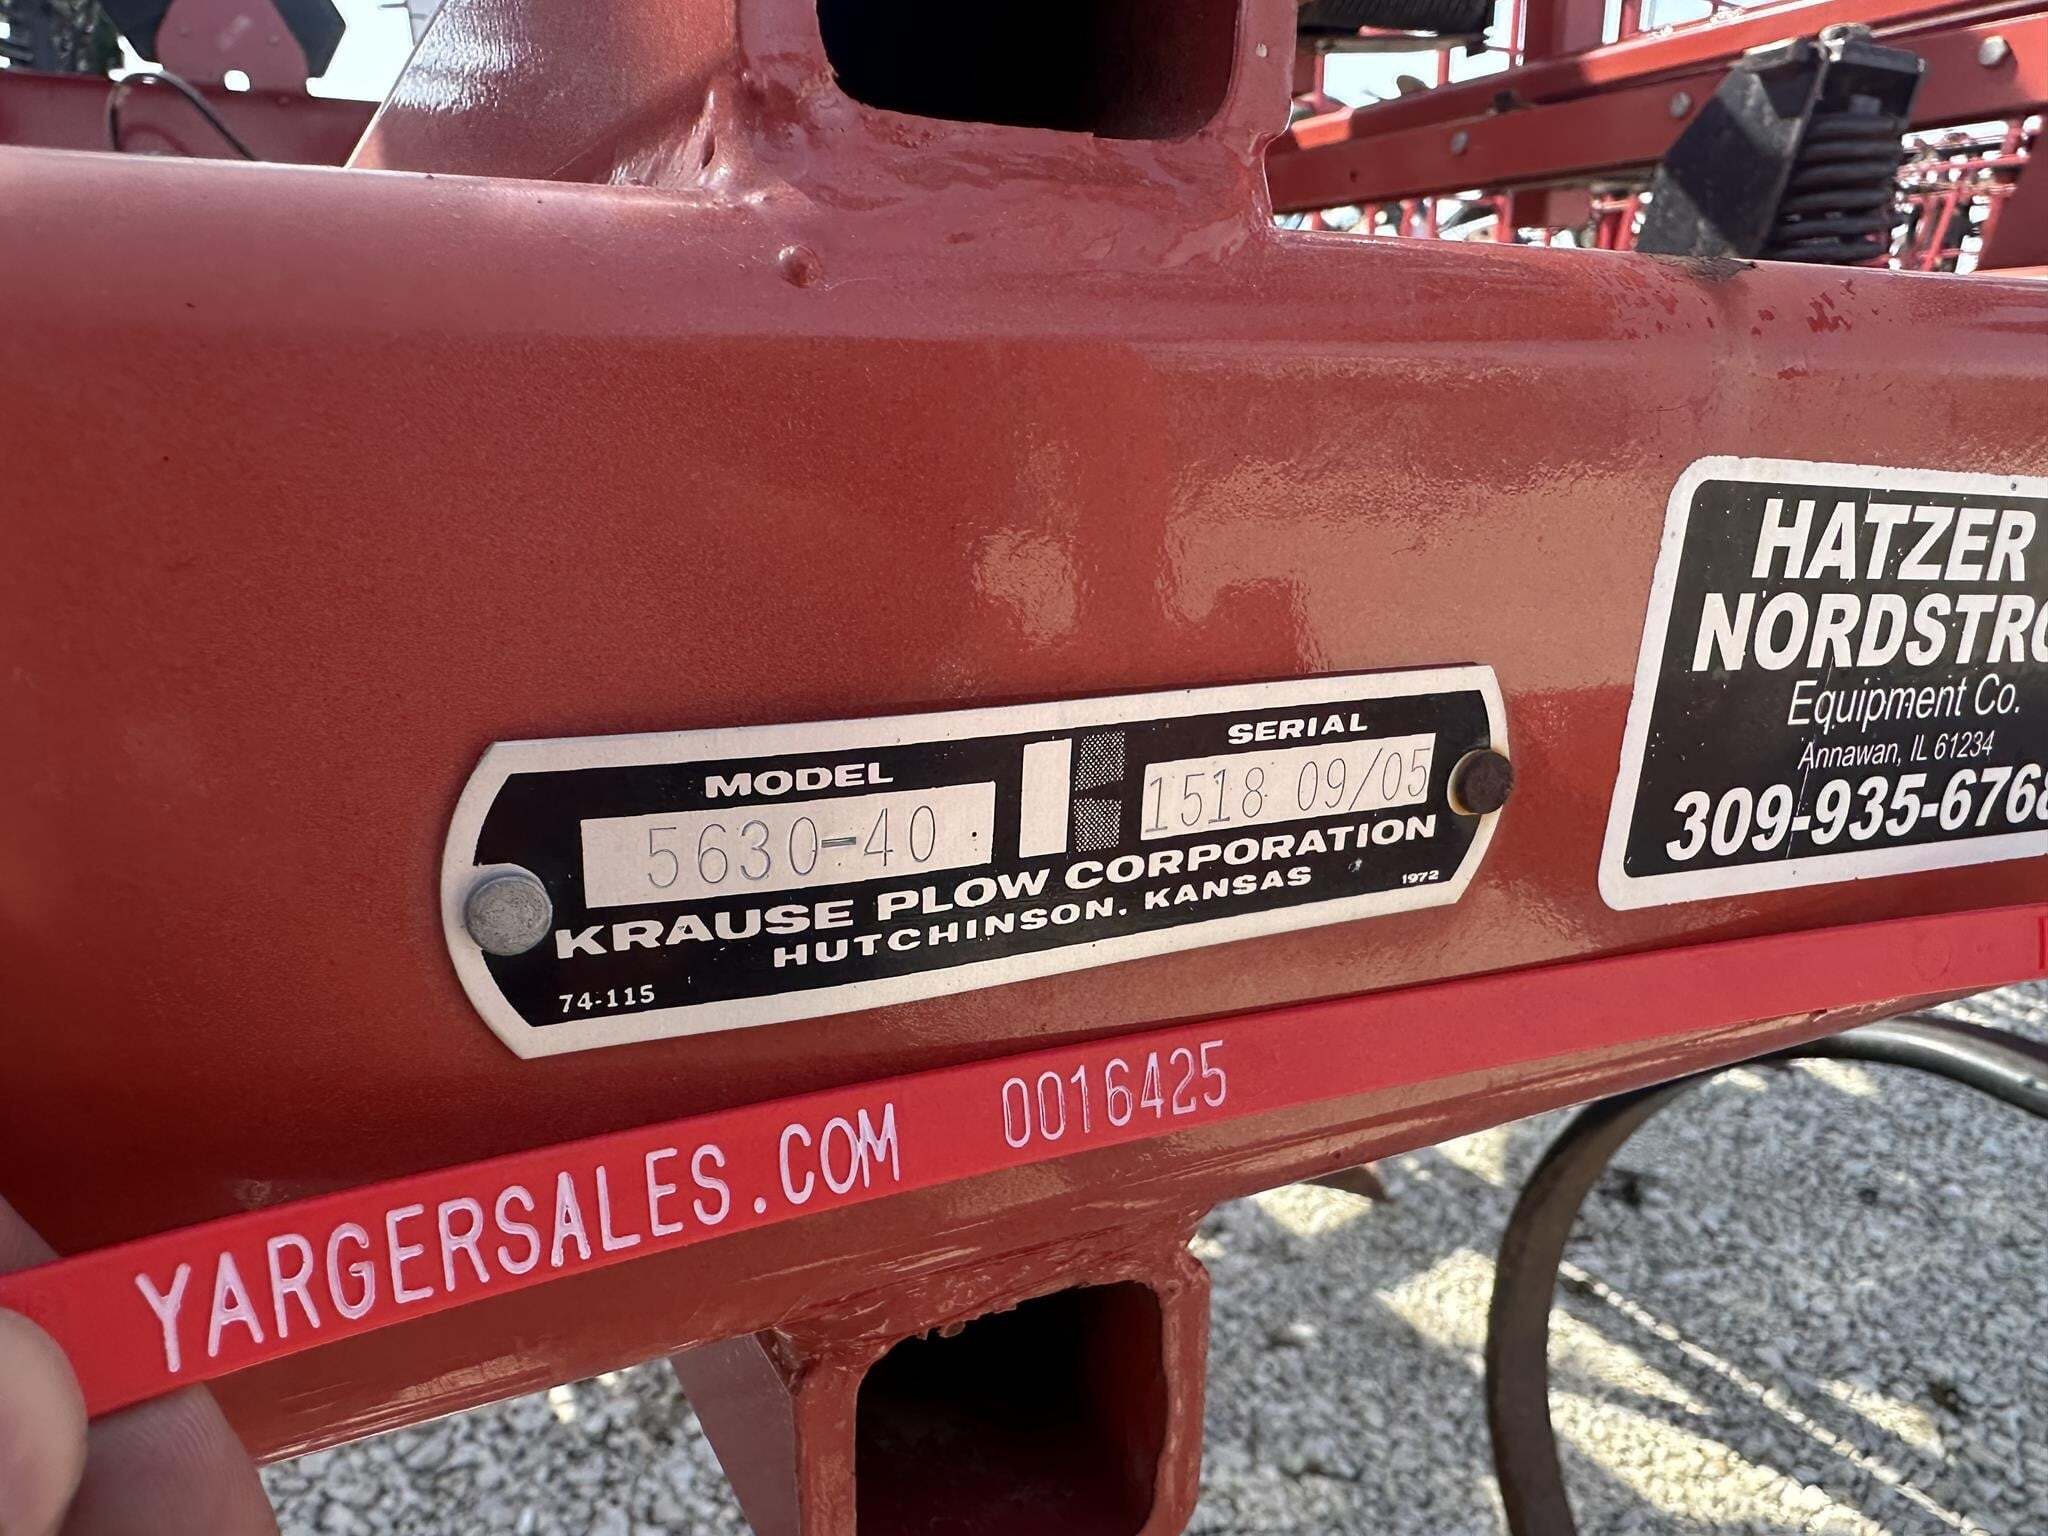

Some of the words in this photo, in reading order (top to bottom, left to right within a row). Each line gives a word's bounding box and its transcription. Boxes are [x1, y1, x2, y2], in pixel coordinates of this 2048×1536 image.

[1751, 498, 2036, 582] HATZER
[1227, 712, 1368, 746] SERIAL
[1787, 677, 1967, 735] Equipment
[1974, 673, 2020, 716] Co.
[1797, 741, 1902, 771] Annawan,
[1910, 734, 1928, 762] IL
[1934, 730, 1996, 760] 61234
[705, 762, 894, 799] MODEL
[1144, 766, 1266, 833] 1518
[1297, 747, 1432, 812] 09/05
[647, 805, 937, 888] 5630-40
[556, 900, 854, 960] KRAUSE
[877, 868, 1050, 921] PLOW
[1064, 814, 1437, 891] CORPORATION
[1145, 868, 1313, 911] KANSAS
[1401, 869, 1440, 886] 1972
[558, 984, 656, 1014] 74-115
[134, 1102, 902, 1373] YARGERSALES.COM
[1002, 1039, 1227, 1149] 0016425
